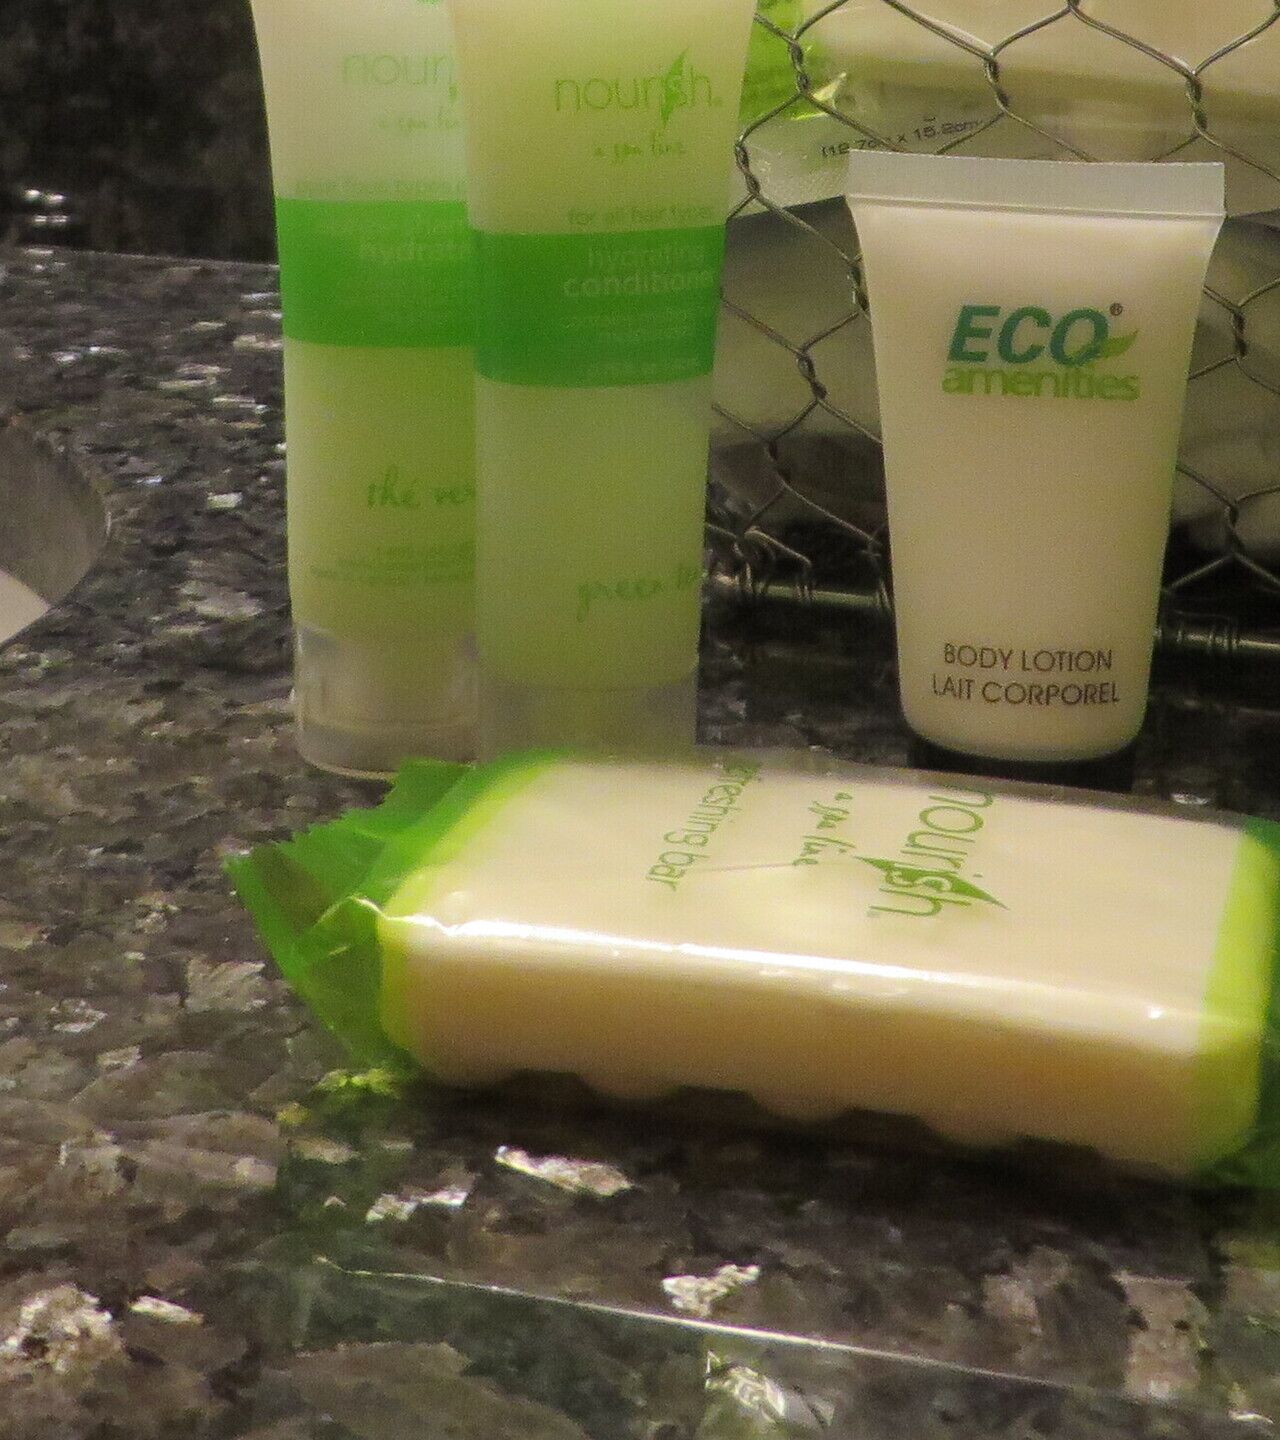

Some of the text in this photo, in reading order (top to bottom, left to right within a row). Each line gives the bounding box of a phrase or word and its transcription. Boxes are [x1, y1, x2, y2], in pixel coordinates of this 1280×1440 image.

[554, 65, 714, 112] nourish
[946, 304, 1110, 369] ECO
[941, 367, 1142, 402] amenities
[944, 642, 1113, 673] BODY LOTION
[933, 673, 1121, 706] LAIT CORPOREL
[645, 850, 711, 892] bar
[869, 783, 994, 917] nourish
